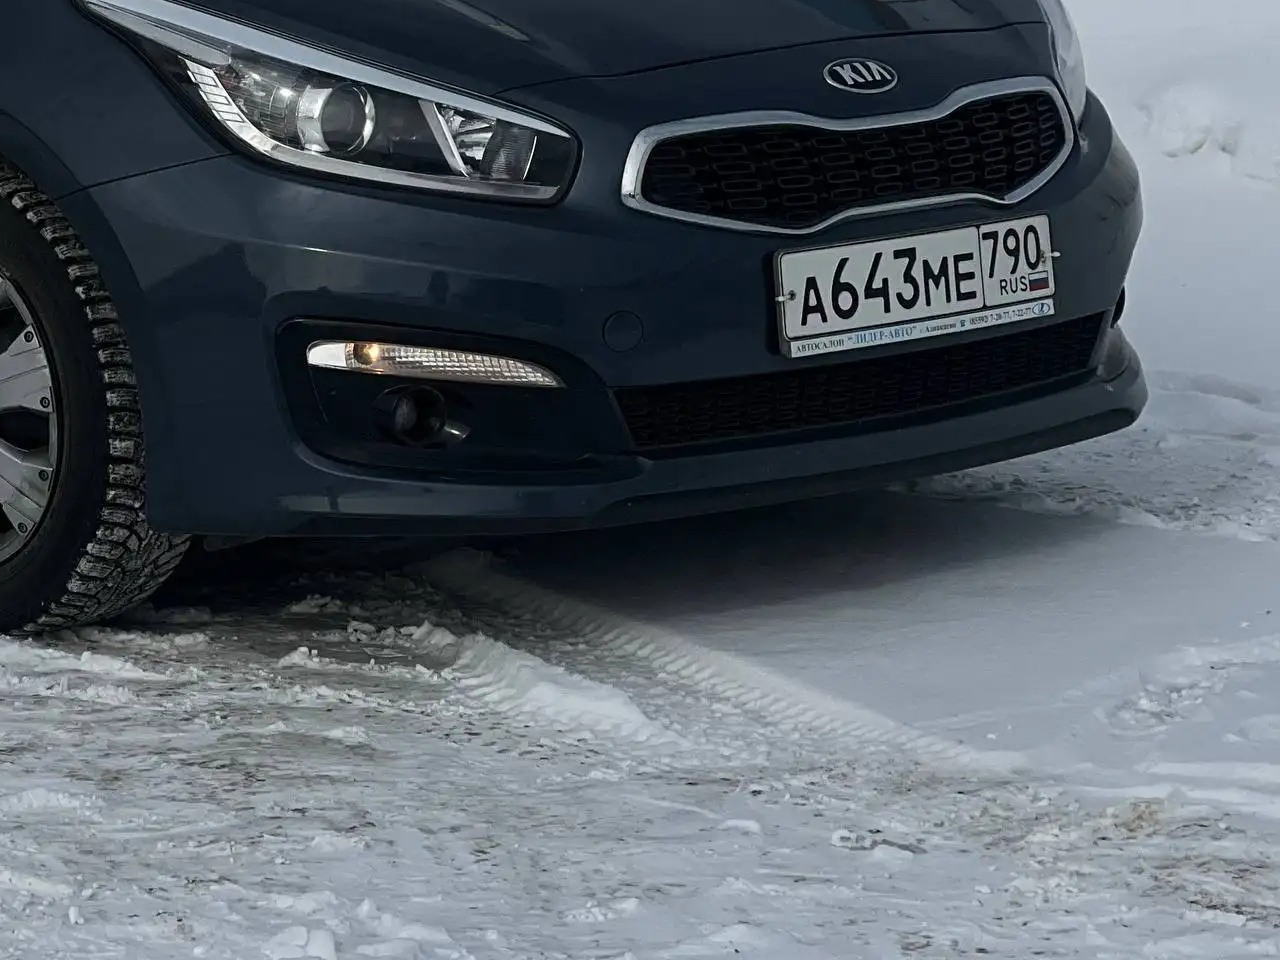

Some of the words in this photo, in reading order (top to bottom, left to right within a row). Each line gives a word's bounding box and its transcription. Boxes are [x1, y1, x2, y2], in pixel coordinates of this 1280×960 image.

[832, 61, 892, 85] KIA
[981, 224, 1042, 279] 790
[999, 275, 1028, 296] RUS
